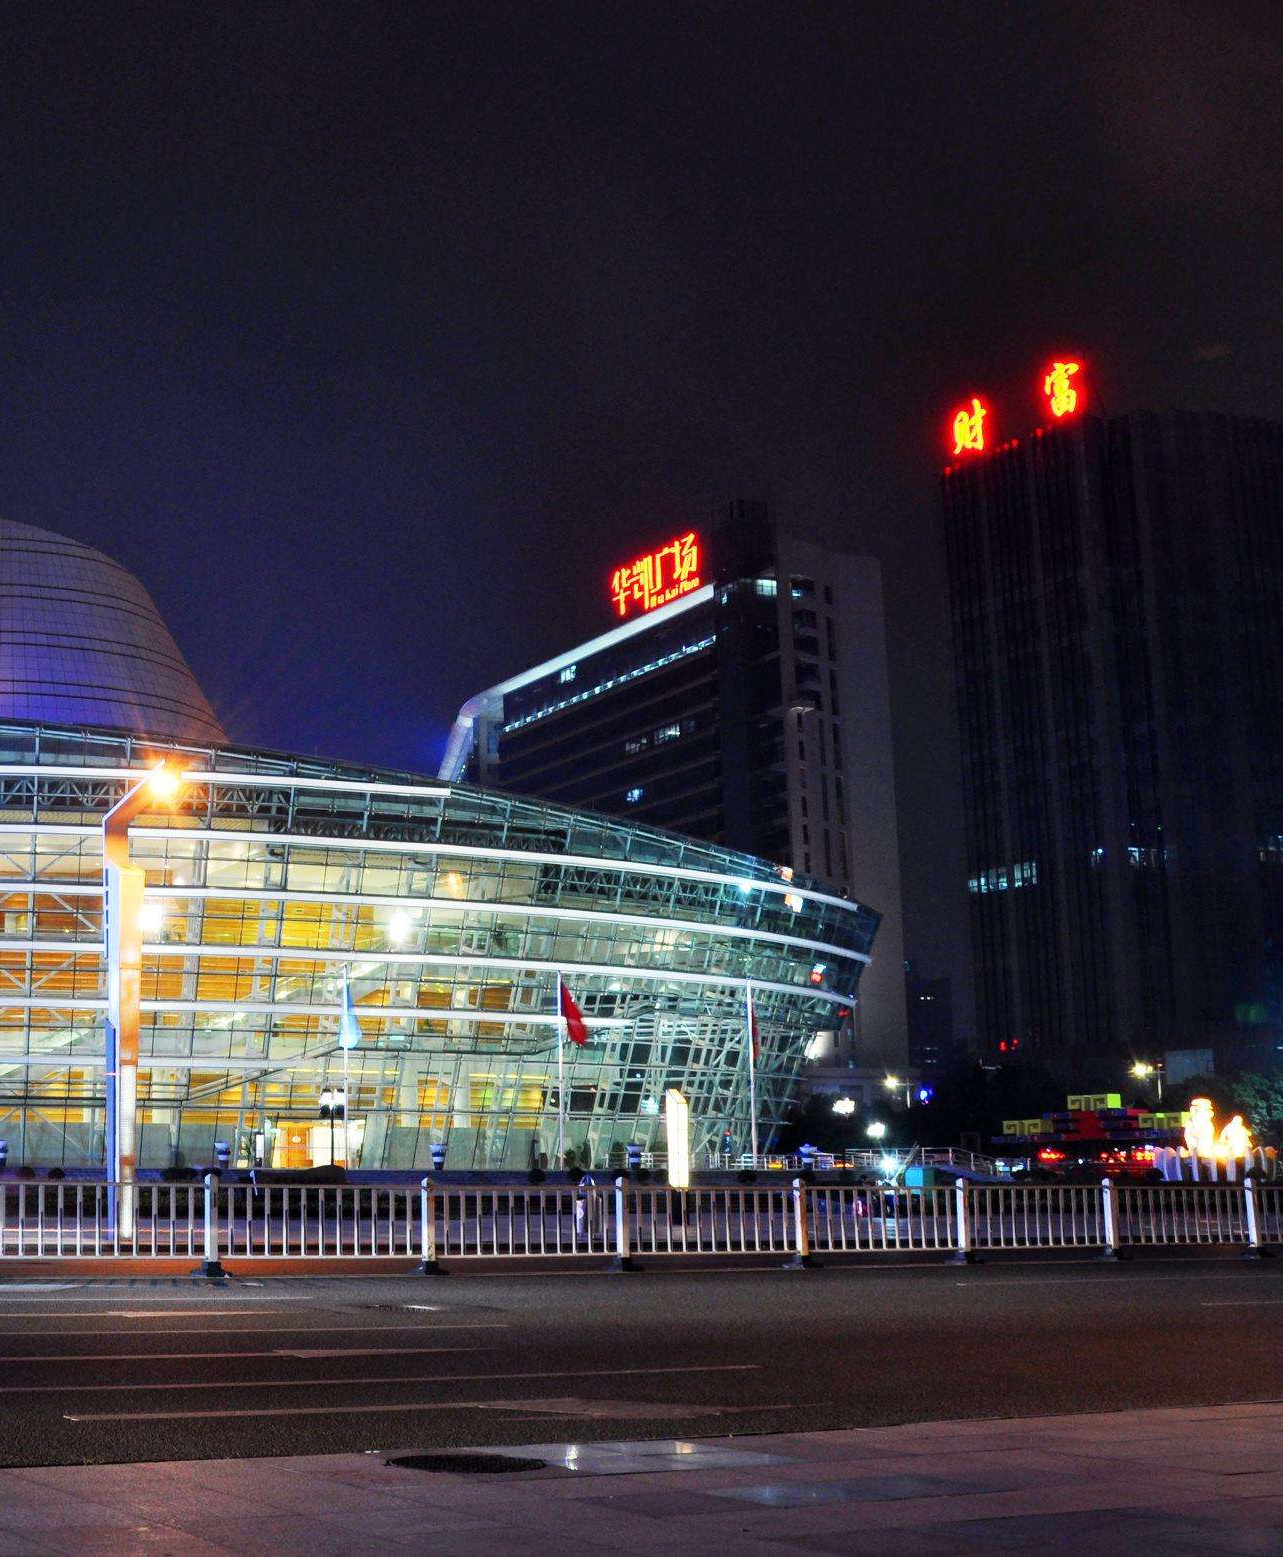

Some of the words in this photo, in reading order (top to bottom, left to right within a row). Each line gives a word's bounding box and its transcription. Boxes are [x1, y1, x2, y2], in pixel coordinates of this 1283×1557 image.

[952, 362, 1080, 455] 财富
[611, 532, 698, 616] 华凯广场
